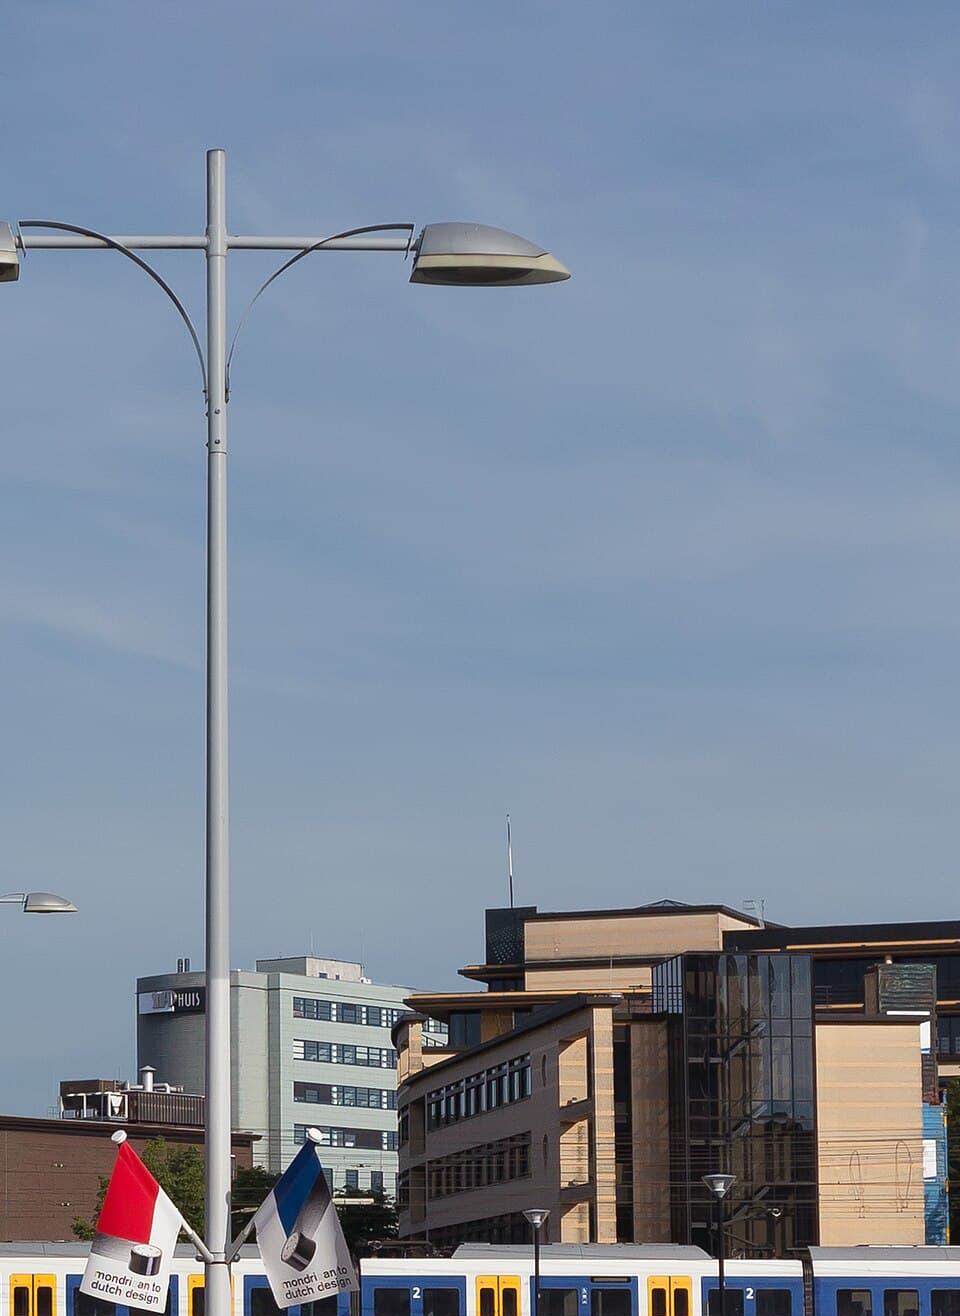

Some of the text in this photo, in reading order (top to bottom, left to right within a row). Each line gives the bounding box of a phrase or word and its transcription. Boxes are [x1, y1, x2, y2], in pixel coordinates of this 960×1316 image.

[91, 1281, 159, 1305] dutch design
[152, 1282, 161, 1293] to
[286, 1277, 351, 1299] dutch design
[412, 1287, 421, 1299] 2
[745, 1287, 755, 1300] 2
